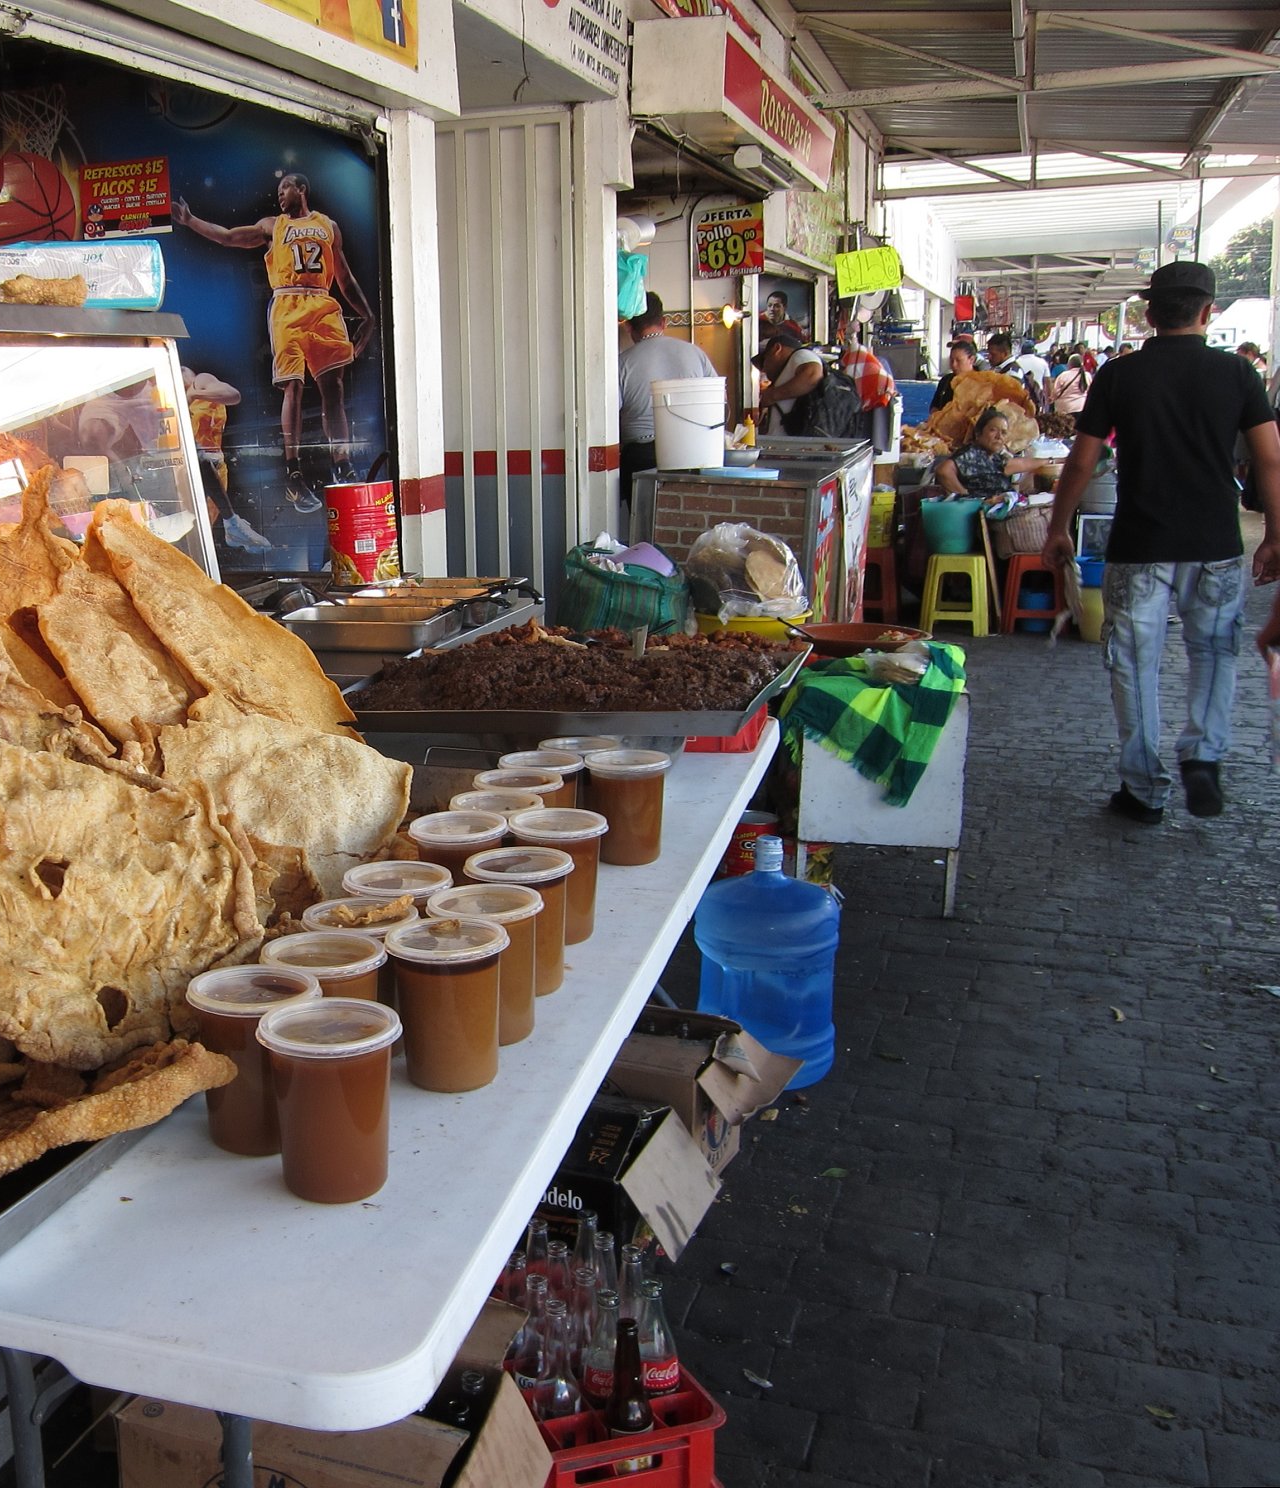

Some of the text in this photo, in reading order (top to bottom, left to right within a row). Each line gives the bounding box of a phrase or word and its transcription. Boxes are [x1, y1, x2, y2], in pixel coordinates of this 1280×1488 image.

[84, 160, 164, 180] REFRESCOS $15
[92, 178, 158, 197] TACOS $15
[121, 212, 150, 221] CARNITAS
[283, 225, 328, 244] LAKERS
[697, 225, 732, 244] Pollo
[291, 242, 323, 274] 12
[730, 266, 762, 276] Rostizado
[539, 1185, 583, 1210] odelo
